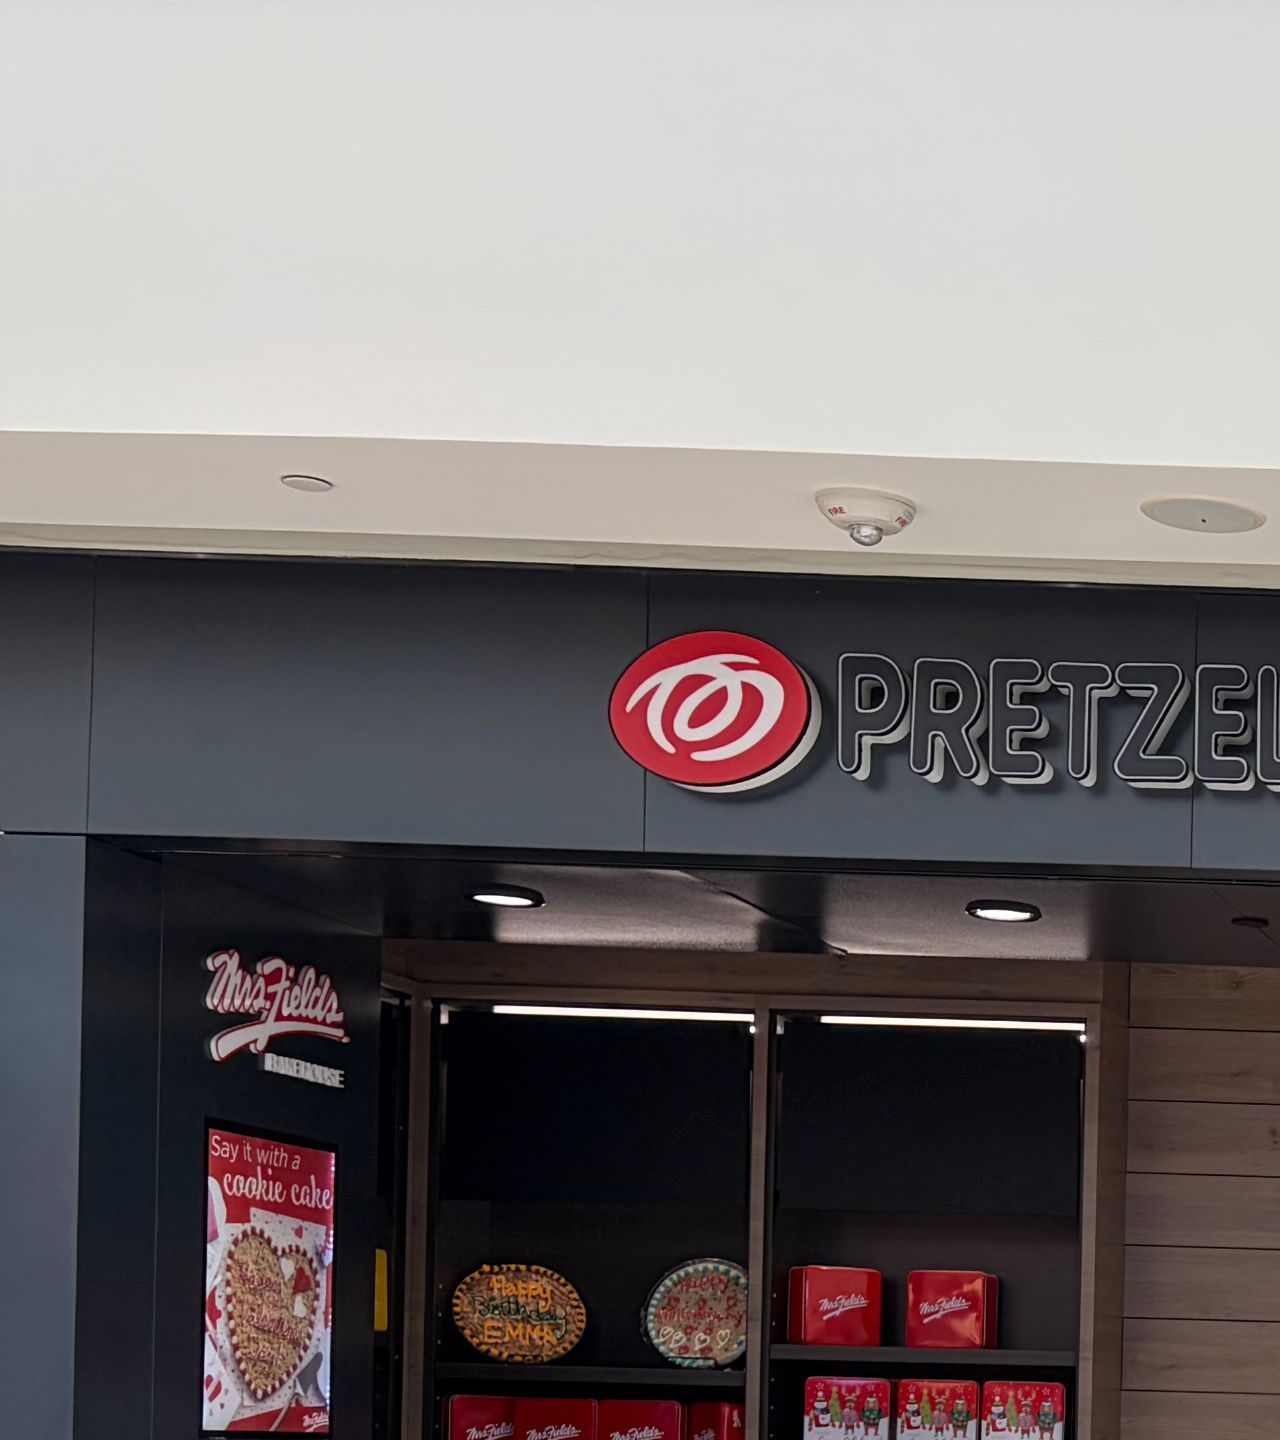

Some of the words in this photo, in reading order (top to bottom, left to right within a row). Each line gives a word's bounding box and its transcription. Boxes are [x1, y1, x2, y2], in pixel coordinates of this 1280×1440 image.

[211, 1135, 239, 1163] Say
[243, 1141, 252, 1163] it
[256, 1145, 288, 1169] with
[291, 1153, 301, 1170] a
[222, 1166, 287, 1203] cookie
[290, 1174, 333, 1211] cake
